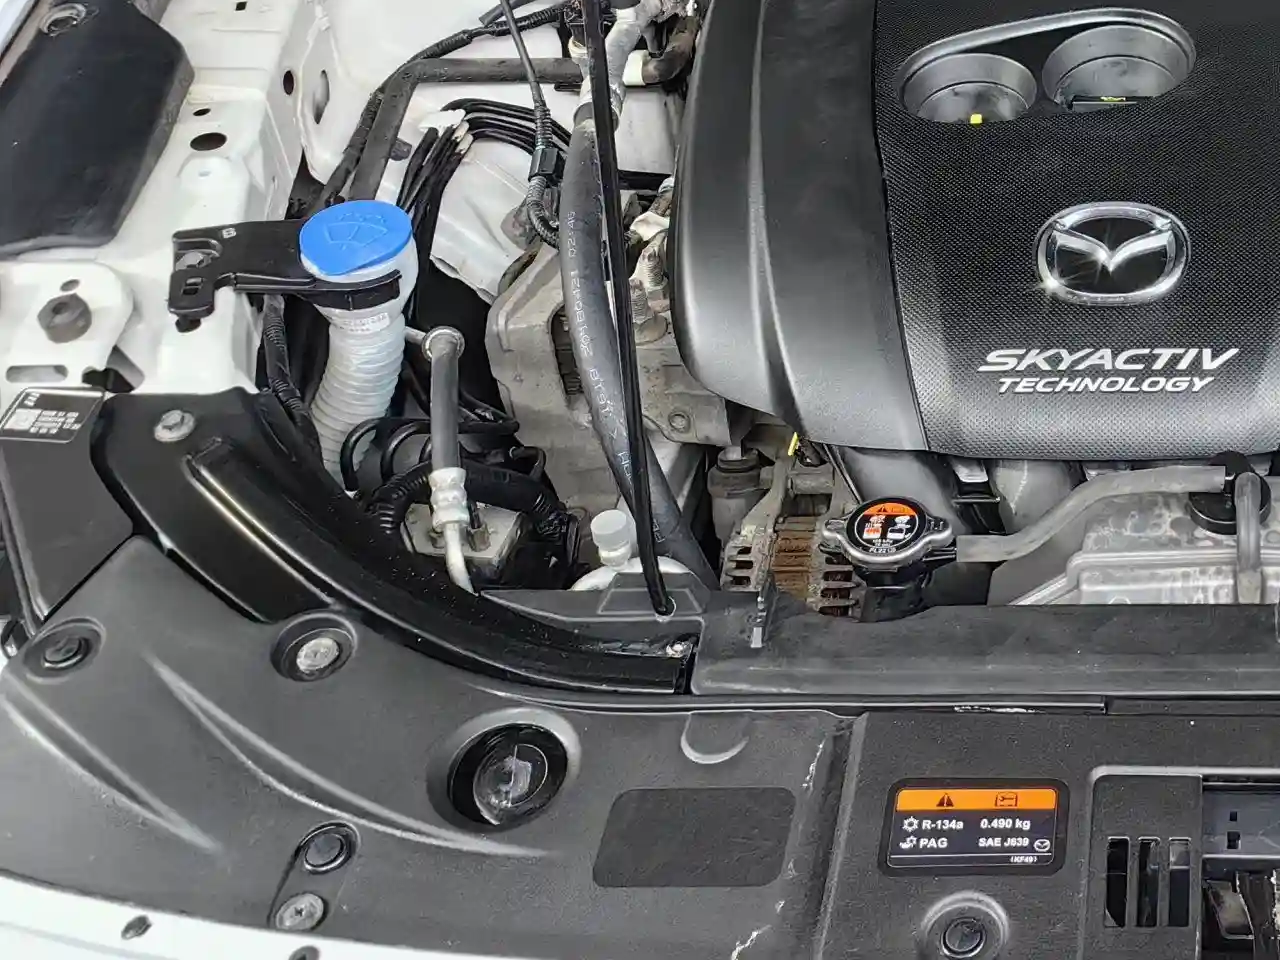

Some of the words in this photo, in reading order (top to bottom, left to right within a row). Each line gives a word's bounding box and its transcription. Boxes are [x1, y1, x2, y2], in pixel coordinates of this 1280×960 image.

[978, 347, 1240, 372] SKYACTIV
[997, 376, 1215, 394] TECHNOLOGY
[921, 819, 964, 830] R-134a
[980, 818, 1013, 829] 0.490
[1014, 818, 1031, 831] kg
[919, 838, 948, 849] PAG
[978, 838, 1001, 847] SAE
[1003, 837, 1030, 847] J639
